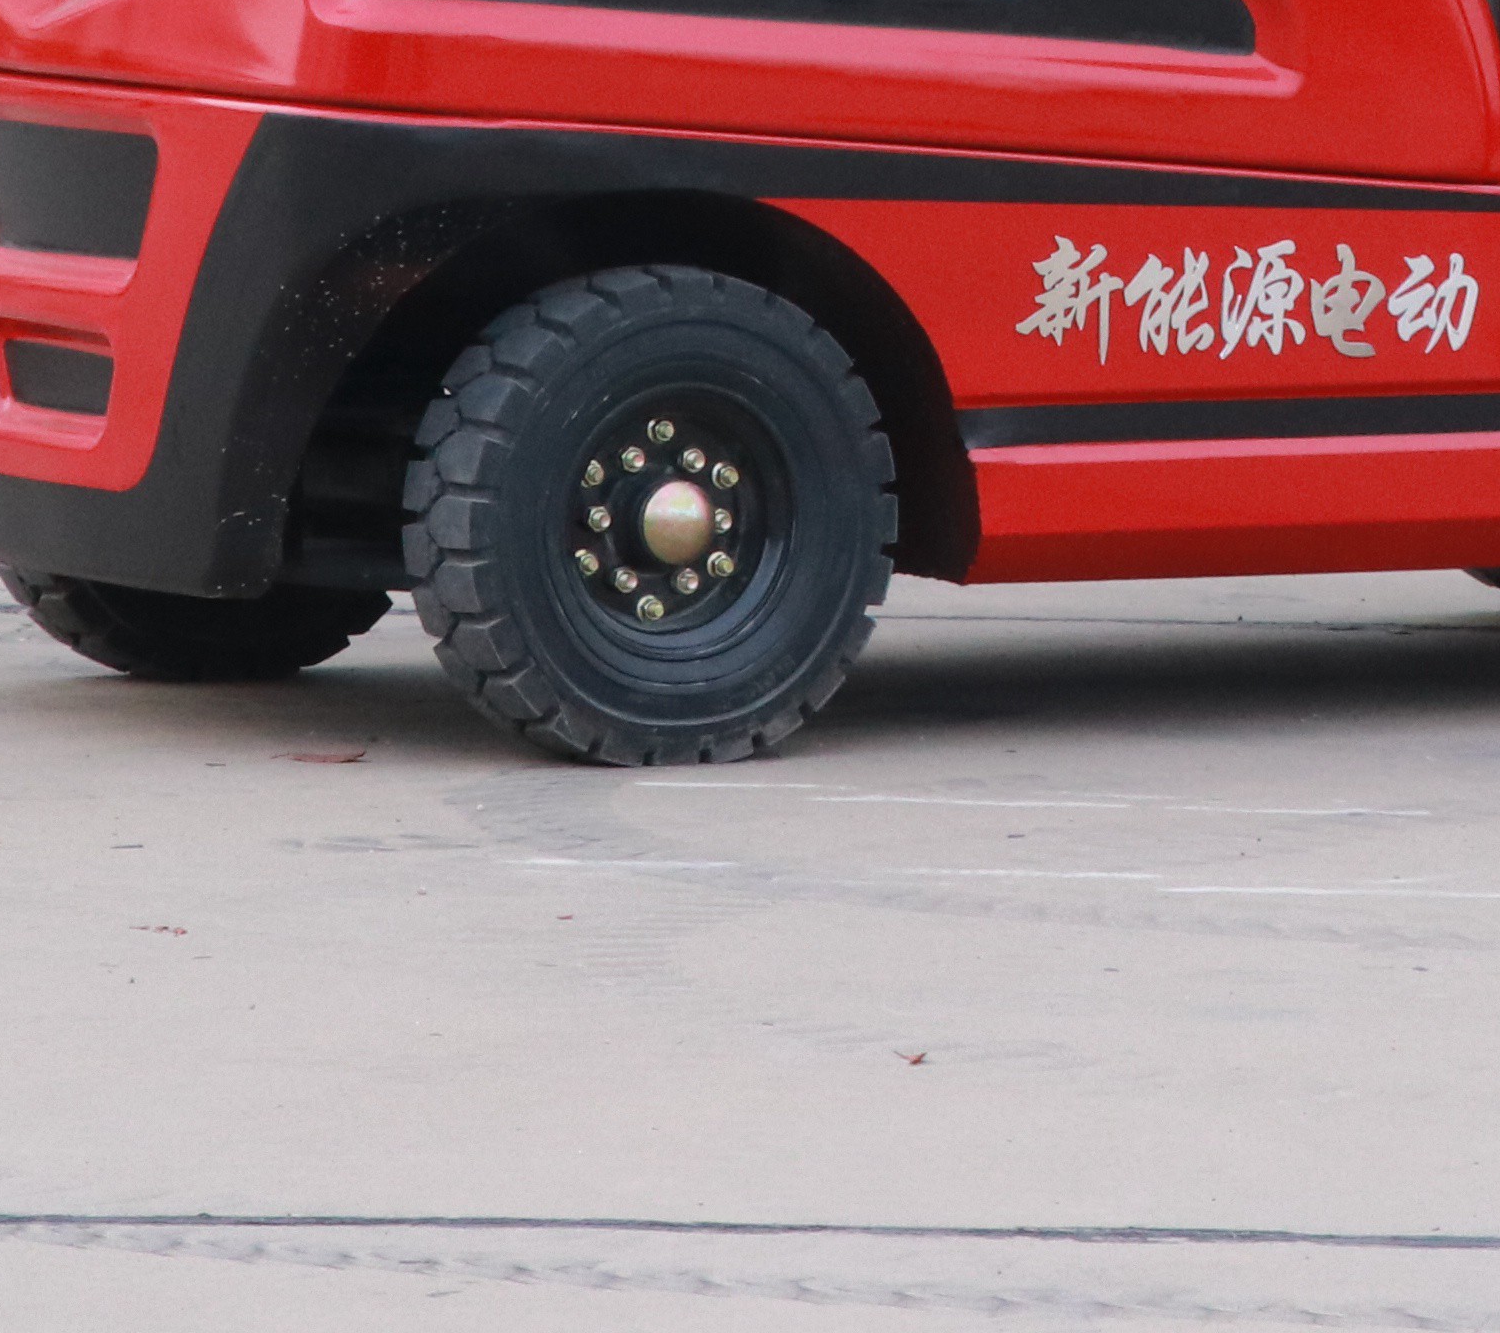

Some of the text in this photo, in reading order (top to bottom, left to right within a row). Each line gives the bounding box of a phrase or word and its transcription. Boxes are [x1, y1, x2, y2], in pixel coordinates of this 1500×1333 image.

[1015, 235, 1480, 366] 新能源电动
